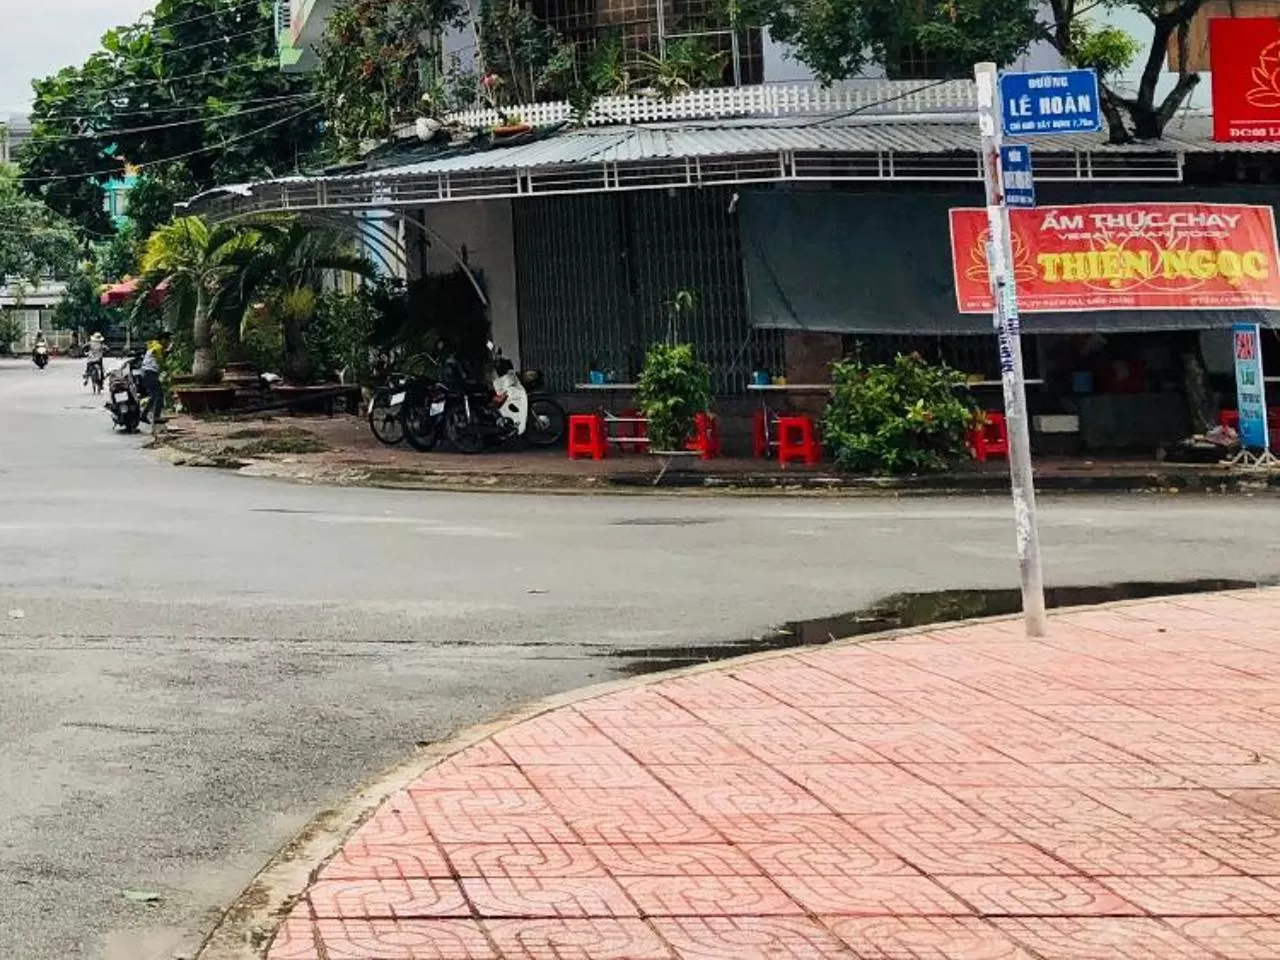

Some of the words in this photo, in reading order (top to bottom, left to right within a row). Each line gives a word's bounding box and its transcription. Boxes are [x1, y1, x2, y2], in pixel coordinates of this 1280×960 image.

[1009, 94, 1033, 117] LÊ
[1039, 91, 1092, 115] HOÀN
[1089, 210, 1167, 231] THỰC
[1167, 212, 1241, 229] CHAY
[1037, 241, 1152, 288] THIỆN
[1160, 249, 1269, 287] NGỌC
